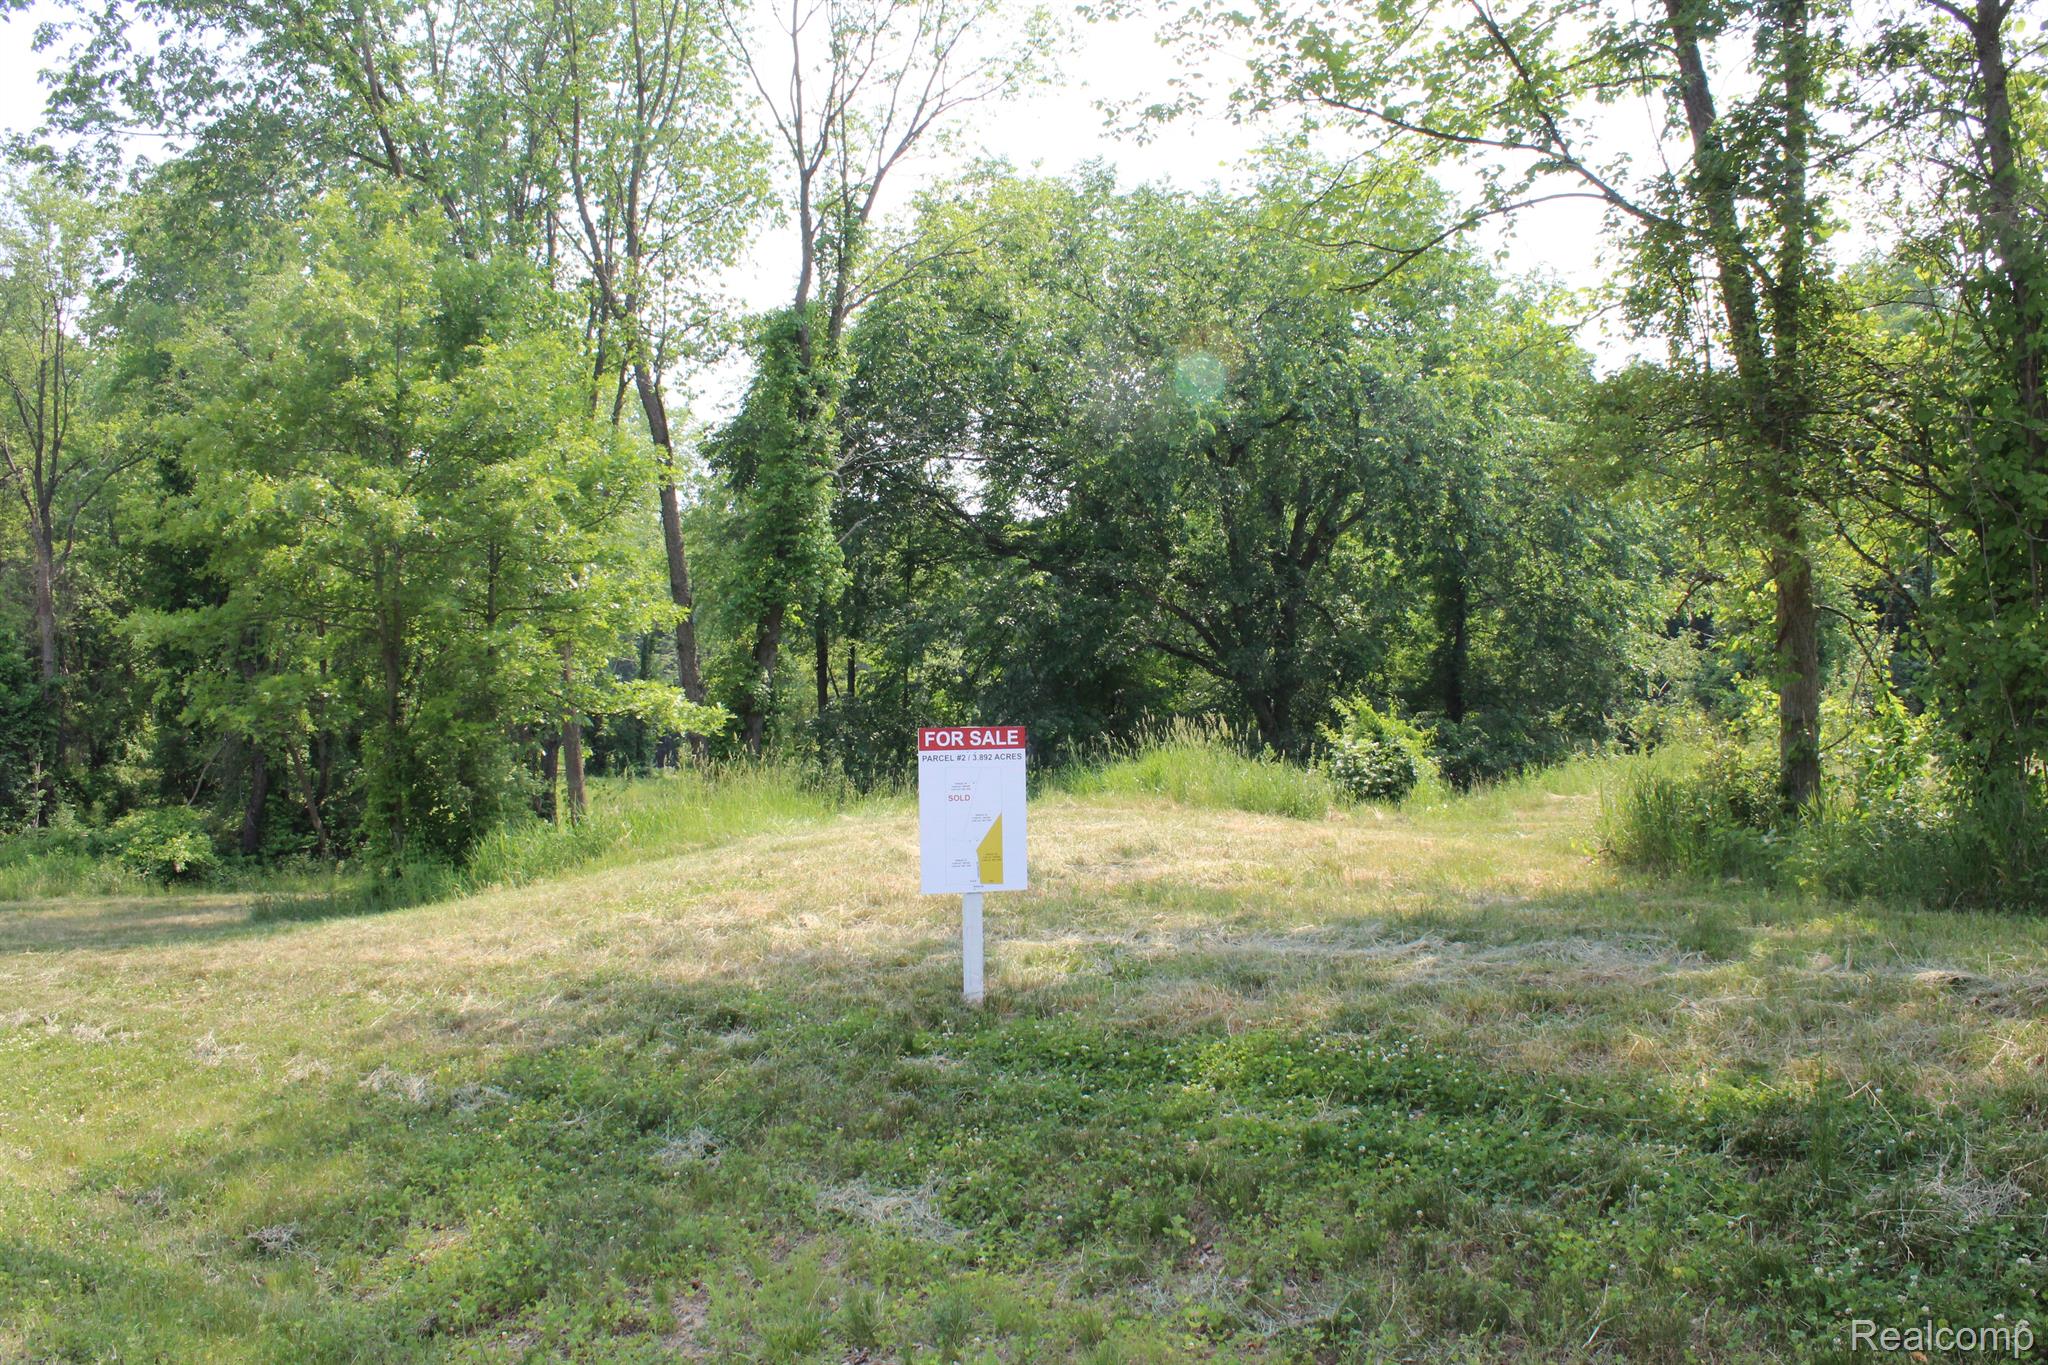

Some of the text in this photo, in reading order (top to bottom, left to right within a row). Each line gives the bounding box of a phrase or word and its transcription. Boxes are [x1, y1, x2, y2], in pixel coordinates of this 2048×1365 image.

[924, 730, 1019, 747] FOR SALE
[922, 754, 954, 762] PARCEL
[948, 794, 971, 802] SOLD
